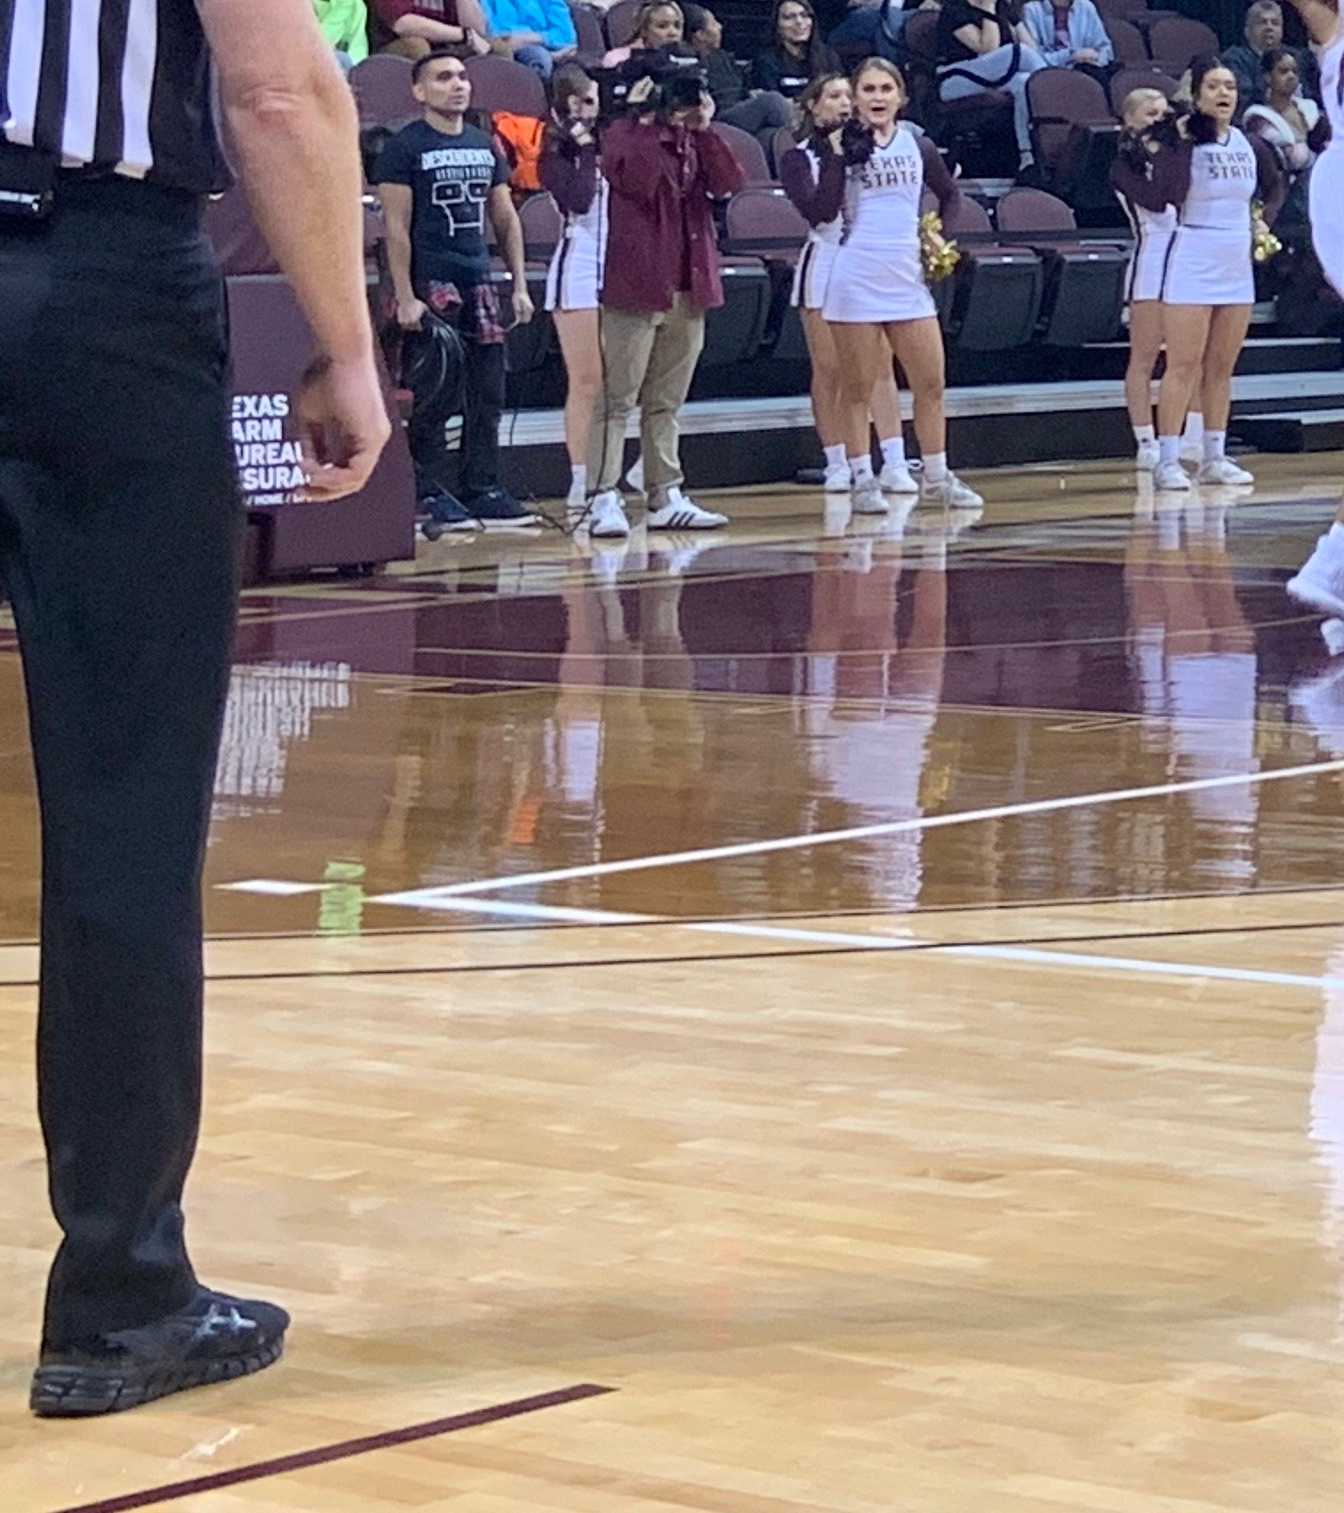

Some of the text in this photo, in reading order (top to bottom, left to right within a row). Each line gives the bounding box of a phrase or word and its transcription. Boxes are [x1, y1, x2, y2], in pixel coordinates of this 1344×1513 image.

[860, 170, 918, 189] STATE
[231, 393, 290, 418] EXAS
[231, 419, 283, 442] ARM
